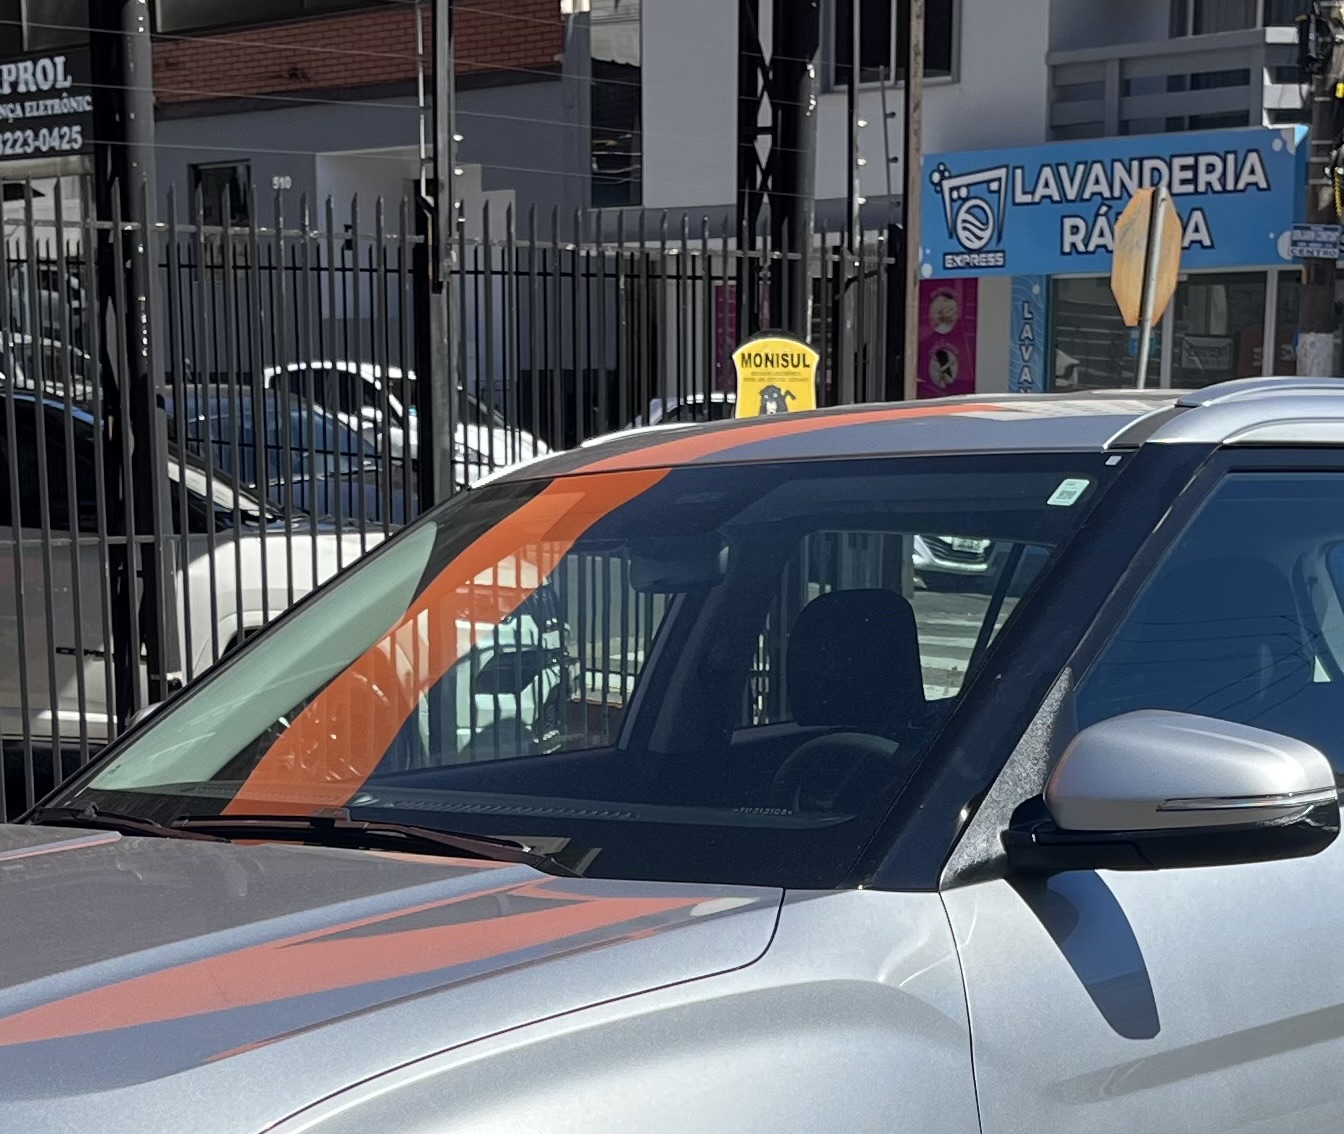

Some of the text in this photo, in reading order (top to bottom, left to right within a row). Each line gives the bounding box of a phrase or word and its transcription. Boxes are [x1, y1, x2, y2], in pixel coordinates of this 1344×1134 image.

[24, 92, 94, 117] ELETRÔNIC
[1013, 151, 1269, 204] LAVANDERIA
[1061, 206, 1213, 253] RÁA
[944, 251, 1005, 268] EXPRESS
[740, 352, 811, 369] MONISUL
